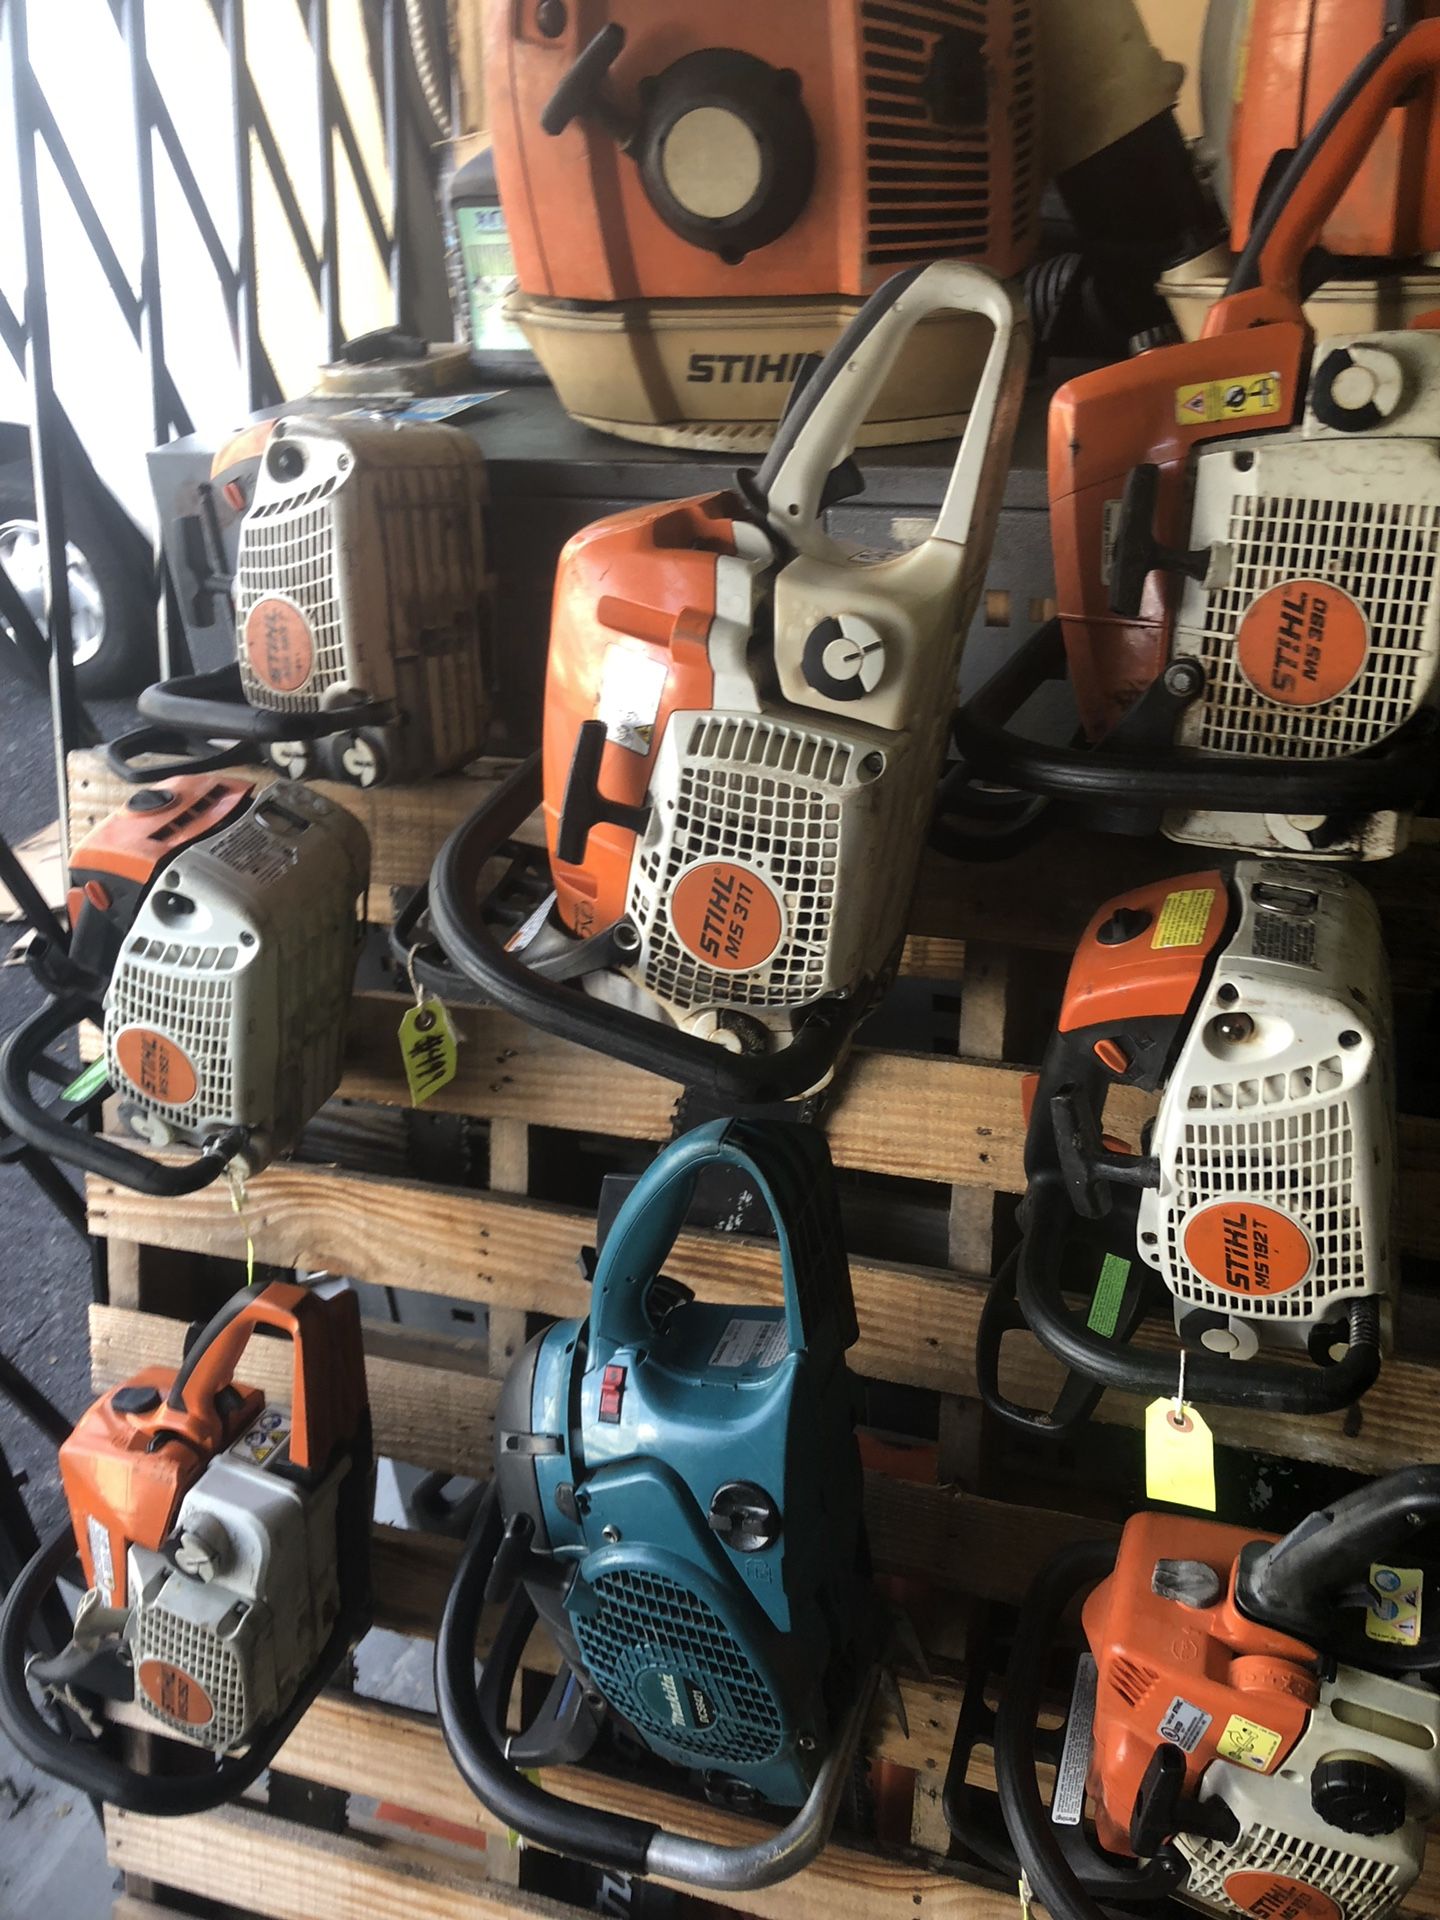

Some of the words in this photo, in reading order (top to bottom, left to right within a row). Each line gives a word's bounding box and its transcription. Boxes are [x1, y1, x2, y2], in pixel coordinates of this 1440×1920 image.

[1271, 592, 1308, 692] STIHL
[1302, 643, 1321, 682] MS
[700, 875, 736, 959] STIHL
[724, 920, 744, 960] MS
[1223, 1213, 1250, 1291] STIHL
[1250, 1882, 1297, 1919] STIHL
